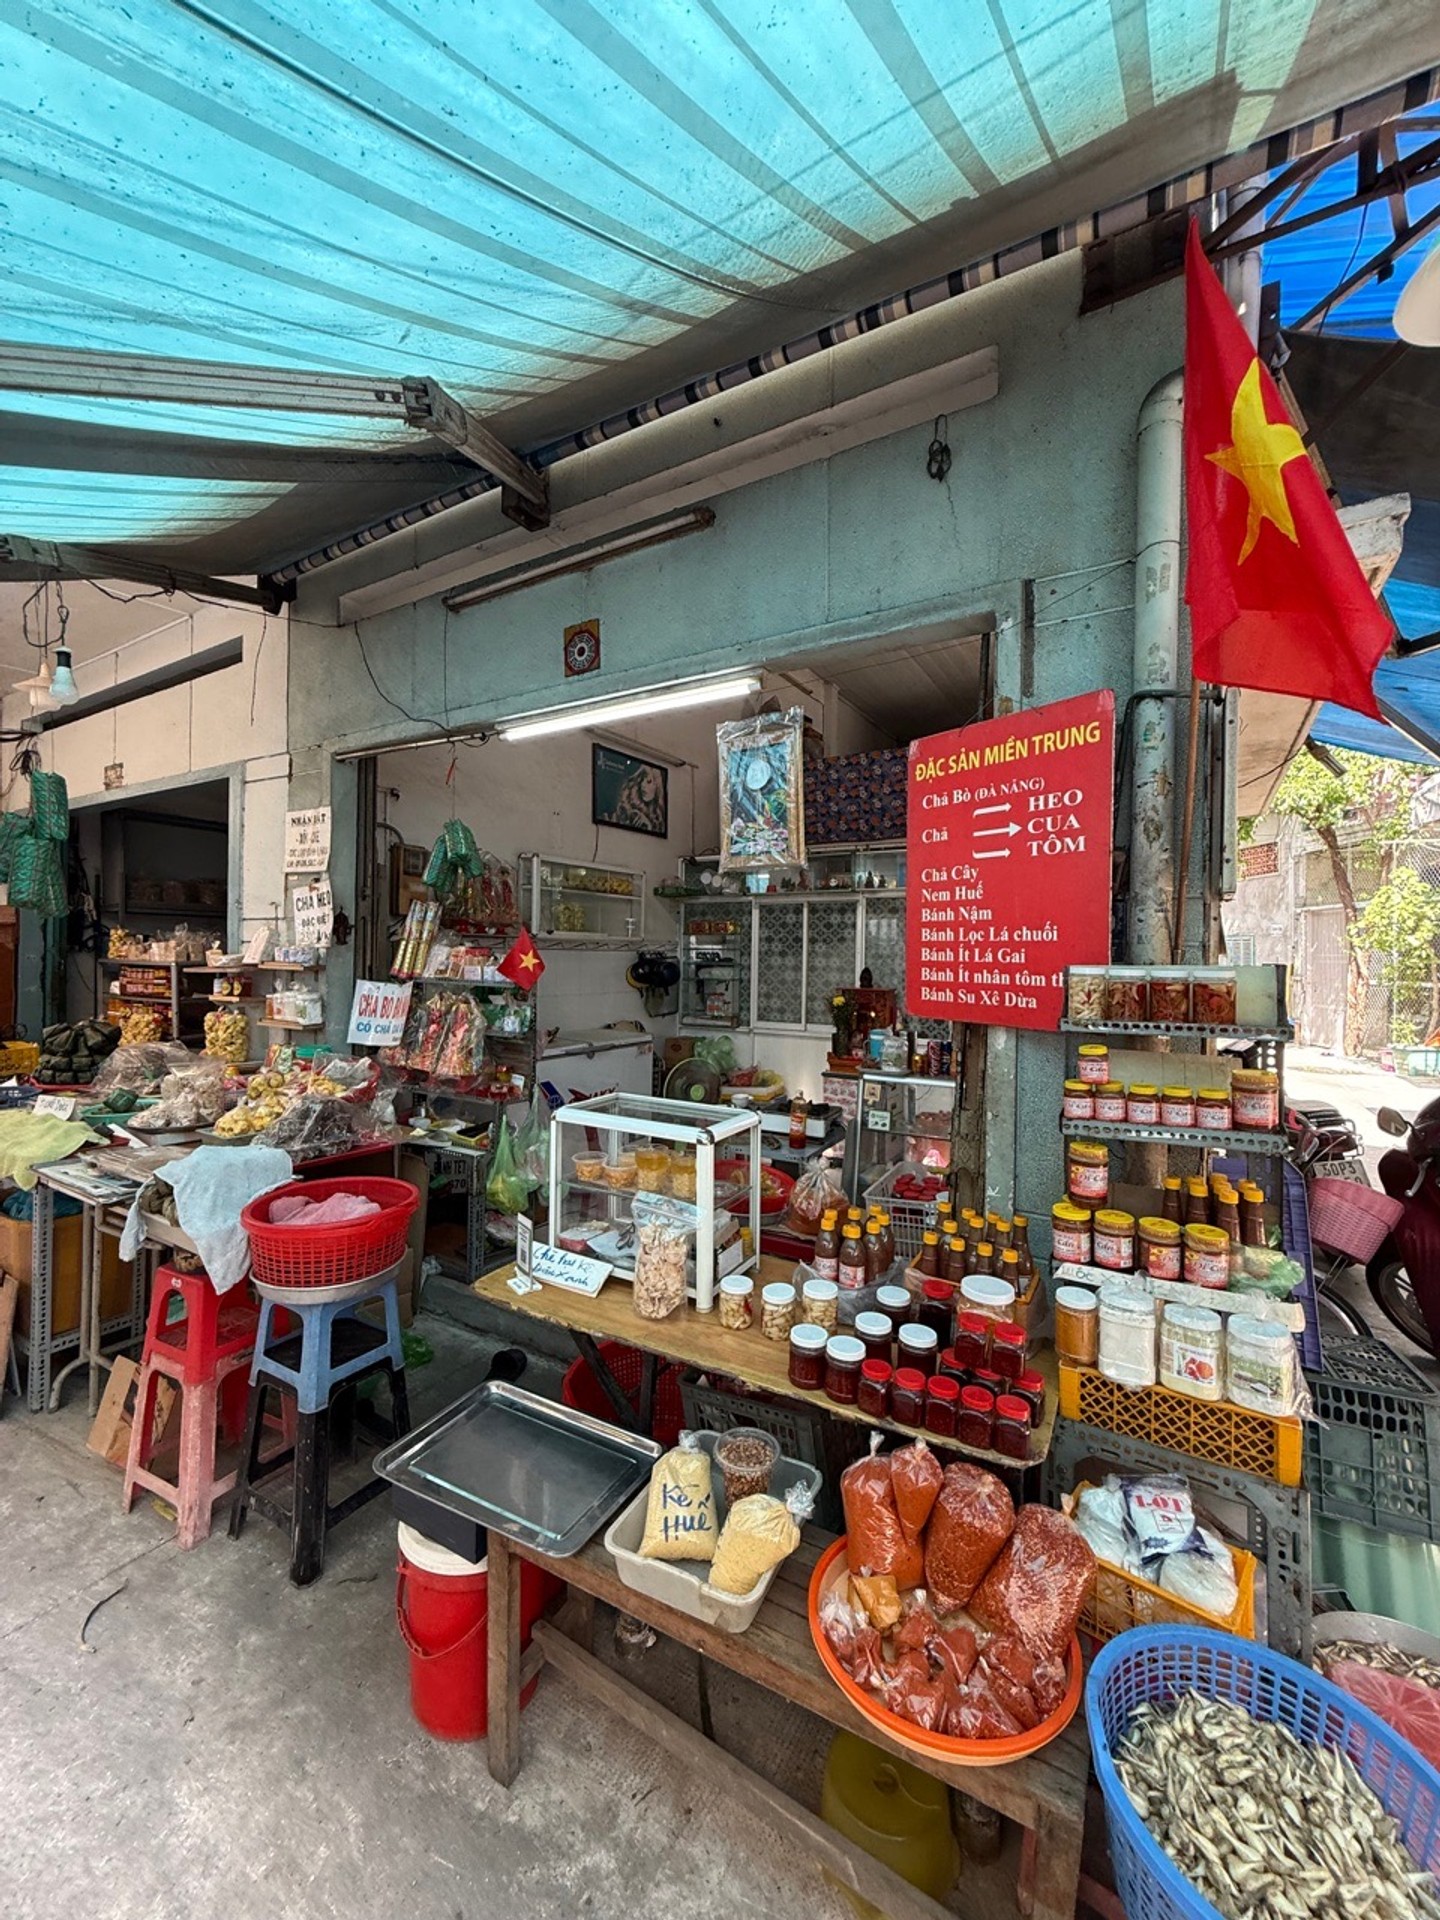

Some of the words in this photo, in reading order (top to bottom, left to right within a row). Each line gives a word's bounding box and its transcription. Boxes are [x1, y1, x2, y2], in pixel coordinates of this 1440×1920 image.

[915, 758, 945, 783] ĐẶC
[948, 748, 980, 774] SẢN
[984, 735, 1028, 767] MIỀN
[1032, 721, 1101, 755] TRUNG
[922, 792, 949, 809] Chả
[953, 788, 971, 804] Bò
[1028, 789, 1083, 813] HEO
[1027, 814, 1080, 834] CUA
[922, 827, 949, 843] Chả
[1027, 834, 1087, 857] TÔM
[921, 867, 948, 883] Chả
[951, 864, 979, 883] Cây
[921, 888, 950, 902] Nem
[955, 880, 984, 900] Huế
[921, 907, 955, 922] Bánh
[959, 905, 992, 924] Nậm
[921, 927, 954, 941] Bánh
[959, 927, 985, 944] Lọc
[989, 926, 1009, 941] Lá
[1013, 921, 1058, 941] chuối
[921, 947, 954, 961] Bánh
[958, 944, 970, 962] Ít
[974, 947, 993, 963] Lá
[997, 948, 1026, 964] Gai
[921, 967, 954, 982] Bánh
[958, 964, 970, 983] Ít
[973, 968, 1010, 985] nhân
[1015, 970, 1046, 986] tôm
[921, 987, 954, 1002] Bánh
[958, 988, 975, 1004] Su
[980, 990, 1000, 1006] Xê
[1004, 992, 1037, 1009] Dừa
[356, 1020, 372, 1033] CÓ
